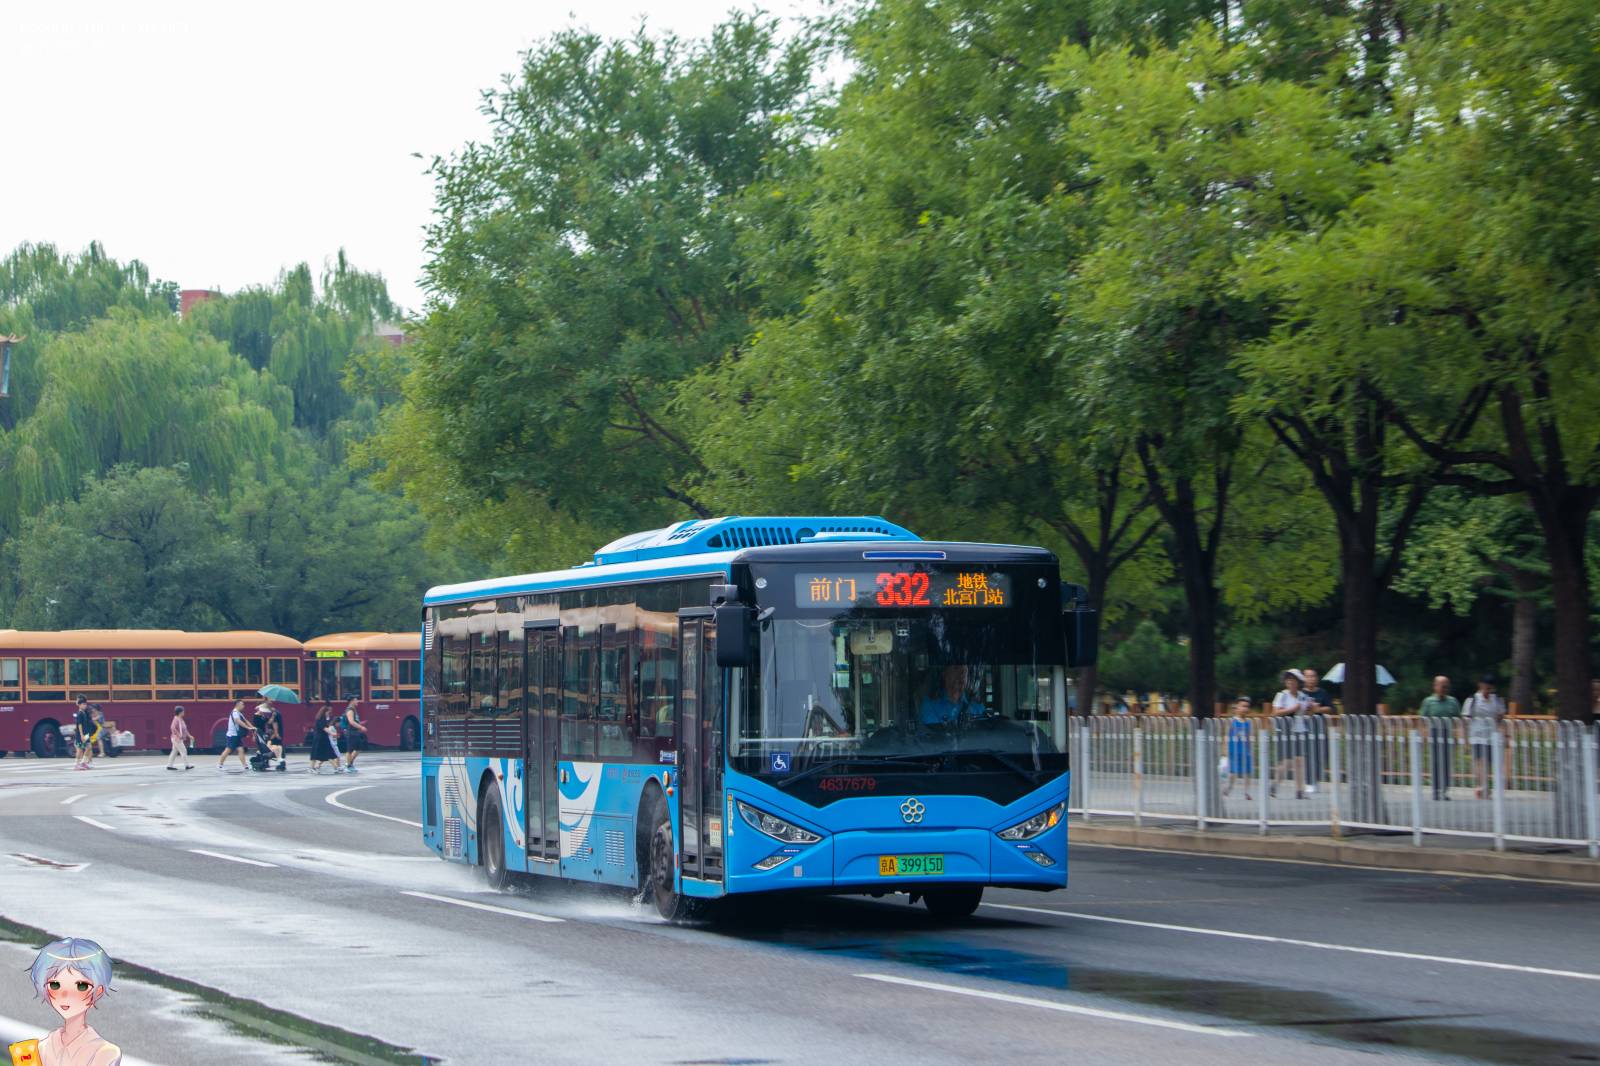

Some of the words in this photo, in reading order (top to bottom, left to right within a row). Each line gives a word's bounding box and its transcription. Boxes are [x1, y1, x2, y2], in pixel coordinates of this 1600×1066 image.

[957, 572, 988, 589] 地铁
[808, 577, 857, 601] 前门
[876, 573, 931, 606] 332
[944, 589, 1004, 605] 北宫门站
[819, 777, 876, 791] 4637679
[881, 859, 895, 872] 京A
[900, 857, 943, 872] 39915D
